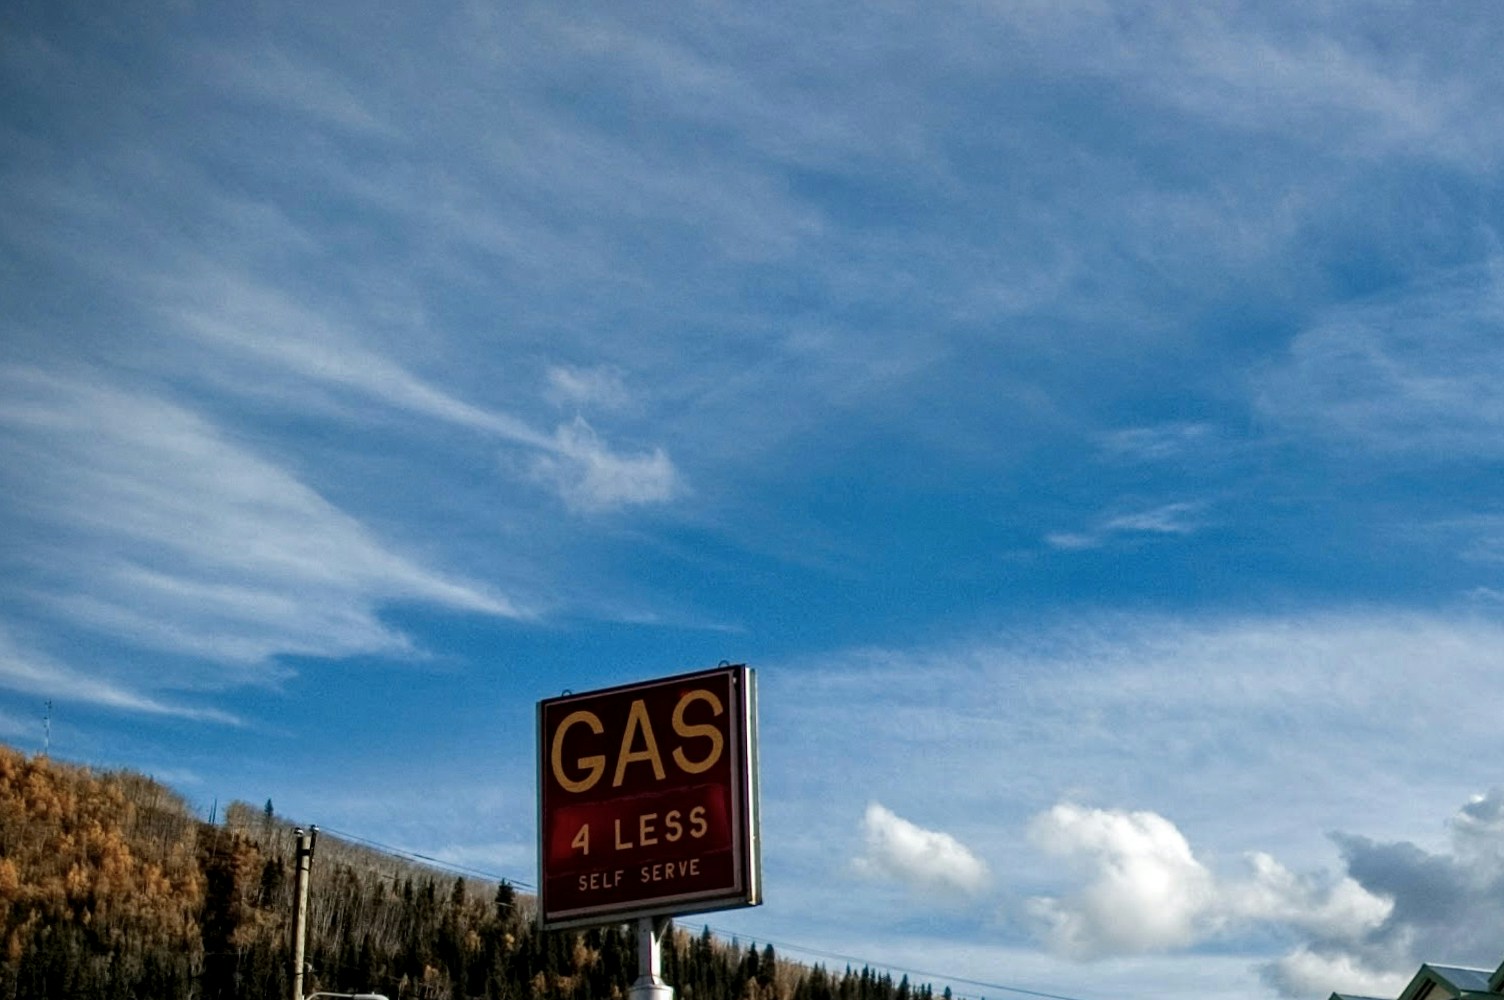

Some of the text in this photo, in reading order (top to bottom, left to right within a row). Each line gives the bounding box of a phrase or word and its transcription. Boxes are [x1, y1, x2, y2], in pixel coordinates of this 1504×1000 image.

[551, 689, 724, 793] GAS
[571, 806, 708, 855] 4 LESS
[578, 858, 700, 891] SELF SERVE
